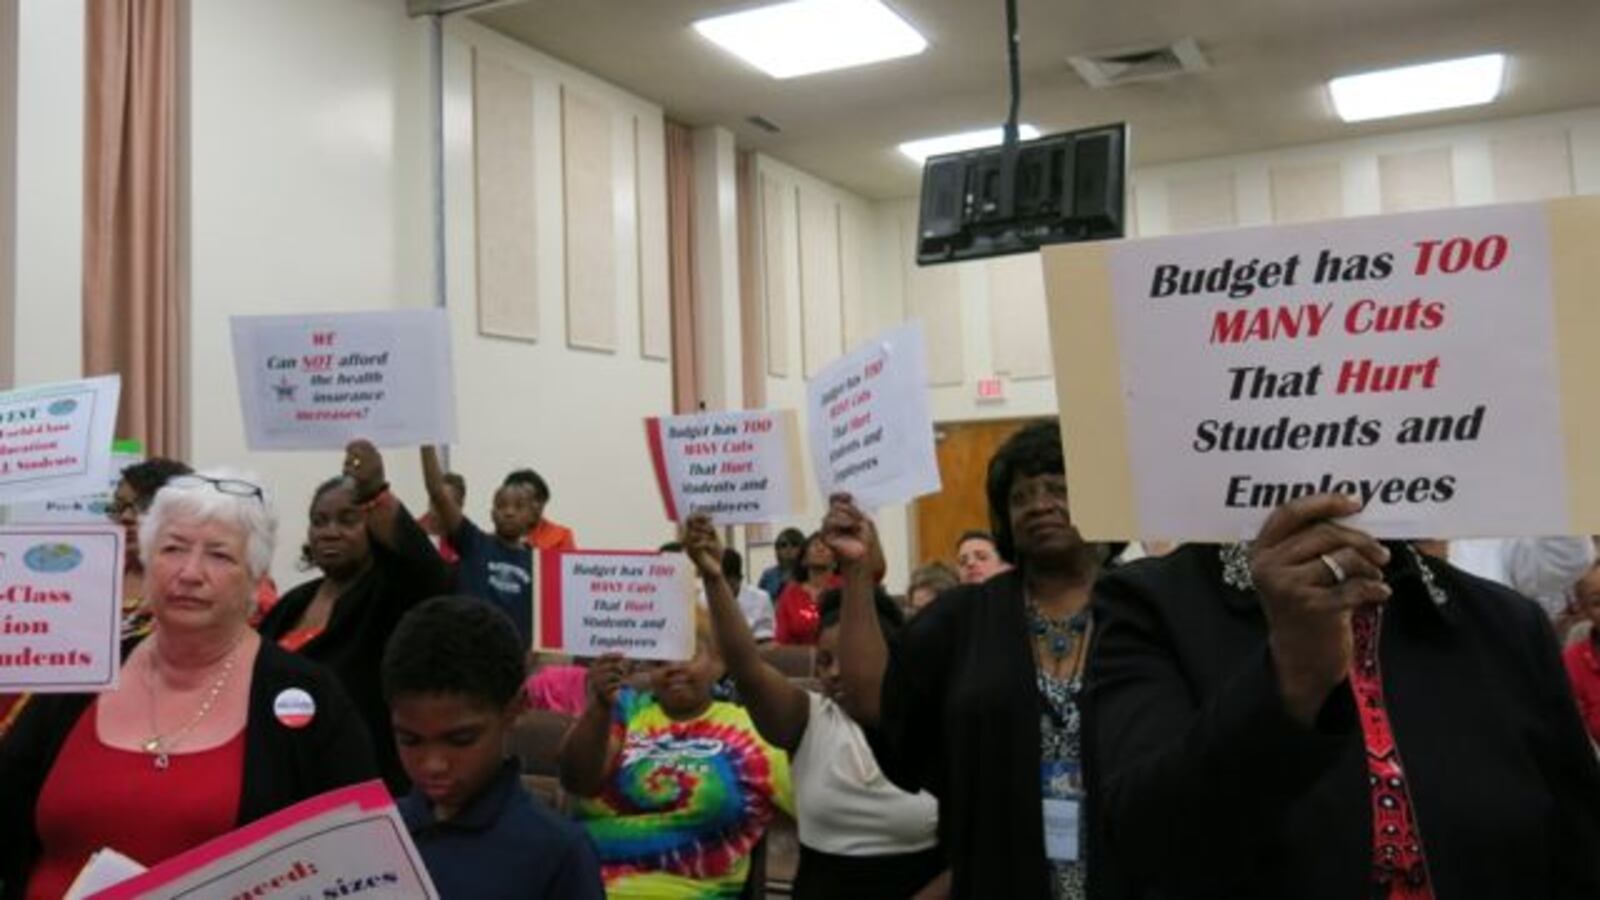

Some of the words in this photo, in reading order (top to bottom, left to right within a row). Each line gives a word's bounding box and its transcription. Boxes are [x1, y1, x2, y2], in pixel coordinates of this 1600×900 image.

[1149, 254, 1301, 298] Budget
[1312, 249, 1394, 285] has
[1413, 234, 1509, 277] TOO
[1209, 303, 1334, 345] MANY
[1344, 298, 1445, 335] Cuts
[337, 372, 383, 385] health
[1228, 364, 1321, 401] That
[1336, 357, 1440, 395] Hurt
[312, 390, 385, 403] insurance
[712, 423, 738, 436] has
[742, 419, 772, 433] TOO
[1193, 416, 1381, 452] Students
[1396, 405, 1486, 444] and
[722, 441, 754, 453] Cuts
[689, 462, 716, 476] That
[719, 461, 753, 474] Hurt
[682, 482, 735, 493] Students
[739, 478, 768, 492] and
[573, 563, 616, 576] Budget
[619, 565, 643, 576] has
[648, 564, 674, 576] TOO
[627, 582, 656, 593] Cuts
[594, 600, 620, 611] That
[624, 600, 654, 612] Hurt
[4, 615, 49, 633] ion
[583, 616, 637, 627] Students
[640, 616, 666, 628] and
[590, 635, 657, 648] Employees
[323, 873, 398, 899] sizes
